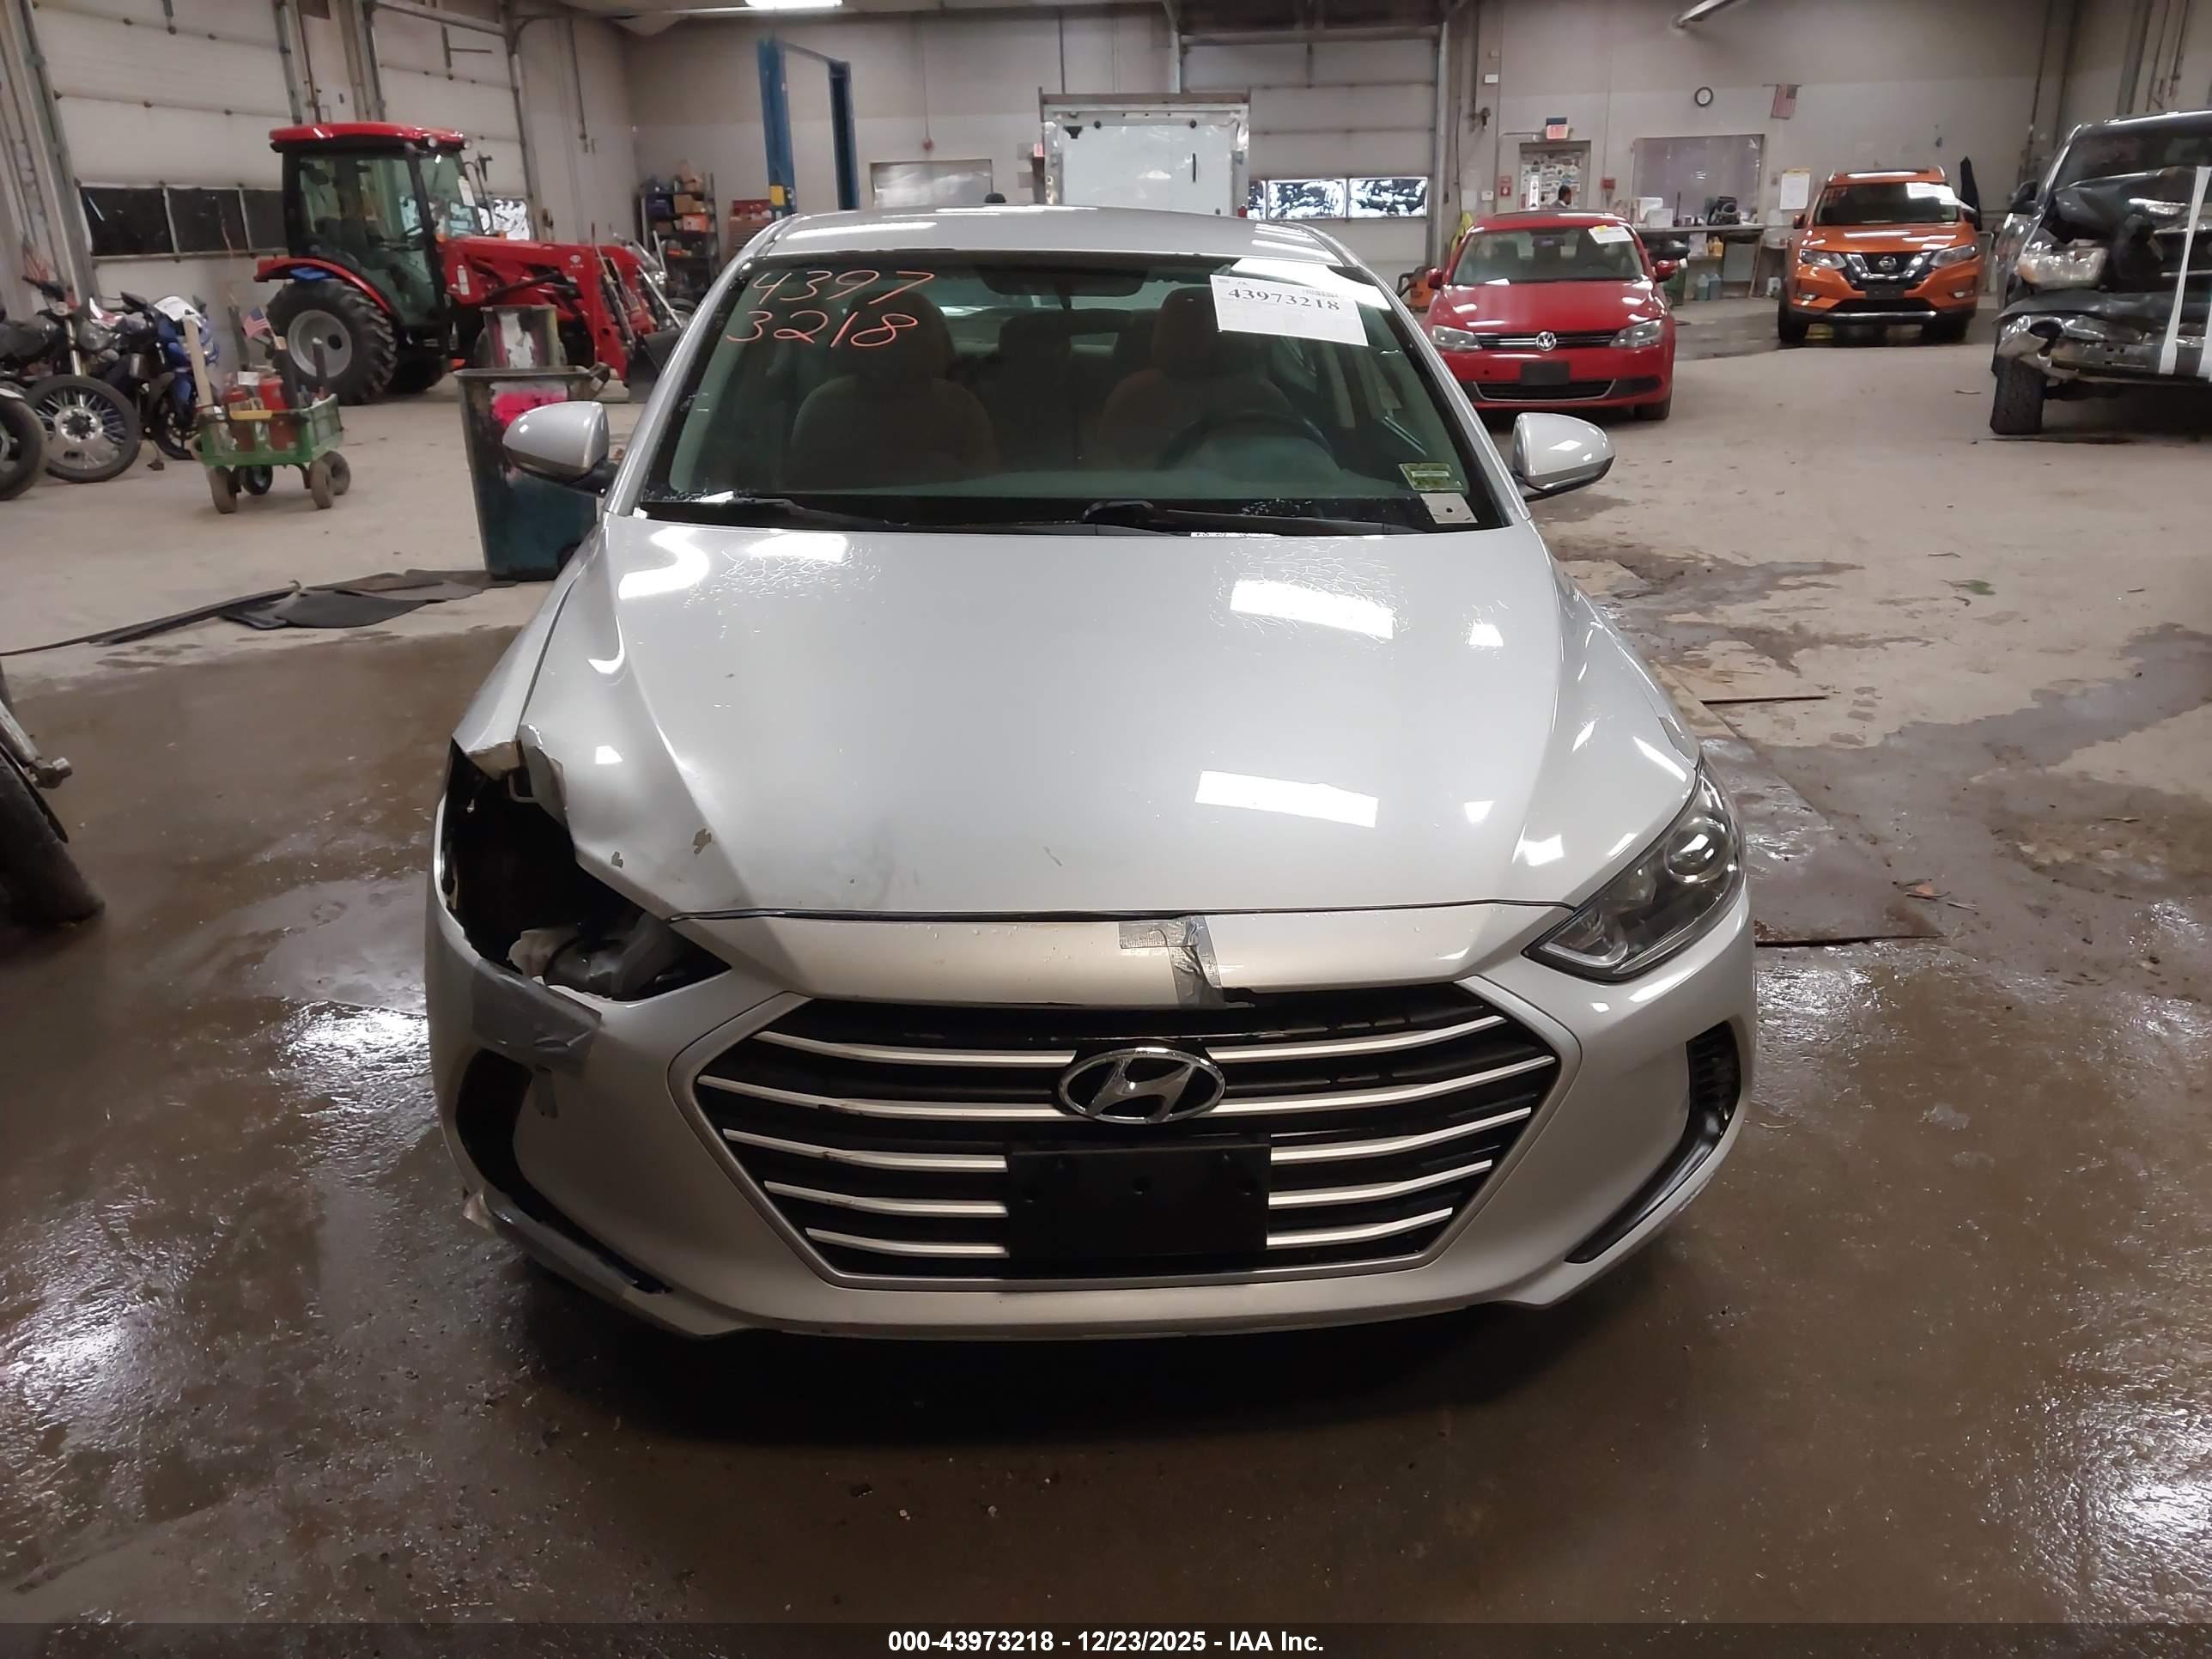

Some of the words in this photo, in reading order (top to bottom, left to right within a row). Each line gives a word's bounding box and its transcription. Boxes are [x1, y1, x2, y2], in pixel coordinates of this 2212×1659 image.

[753, 270, 935, 305] 4397
[1228, 288, 1340, 311] 43973218
[726, 310, 919, 348] 3218
